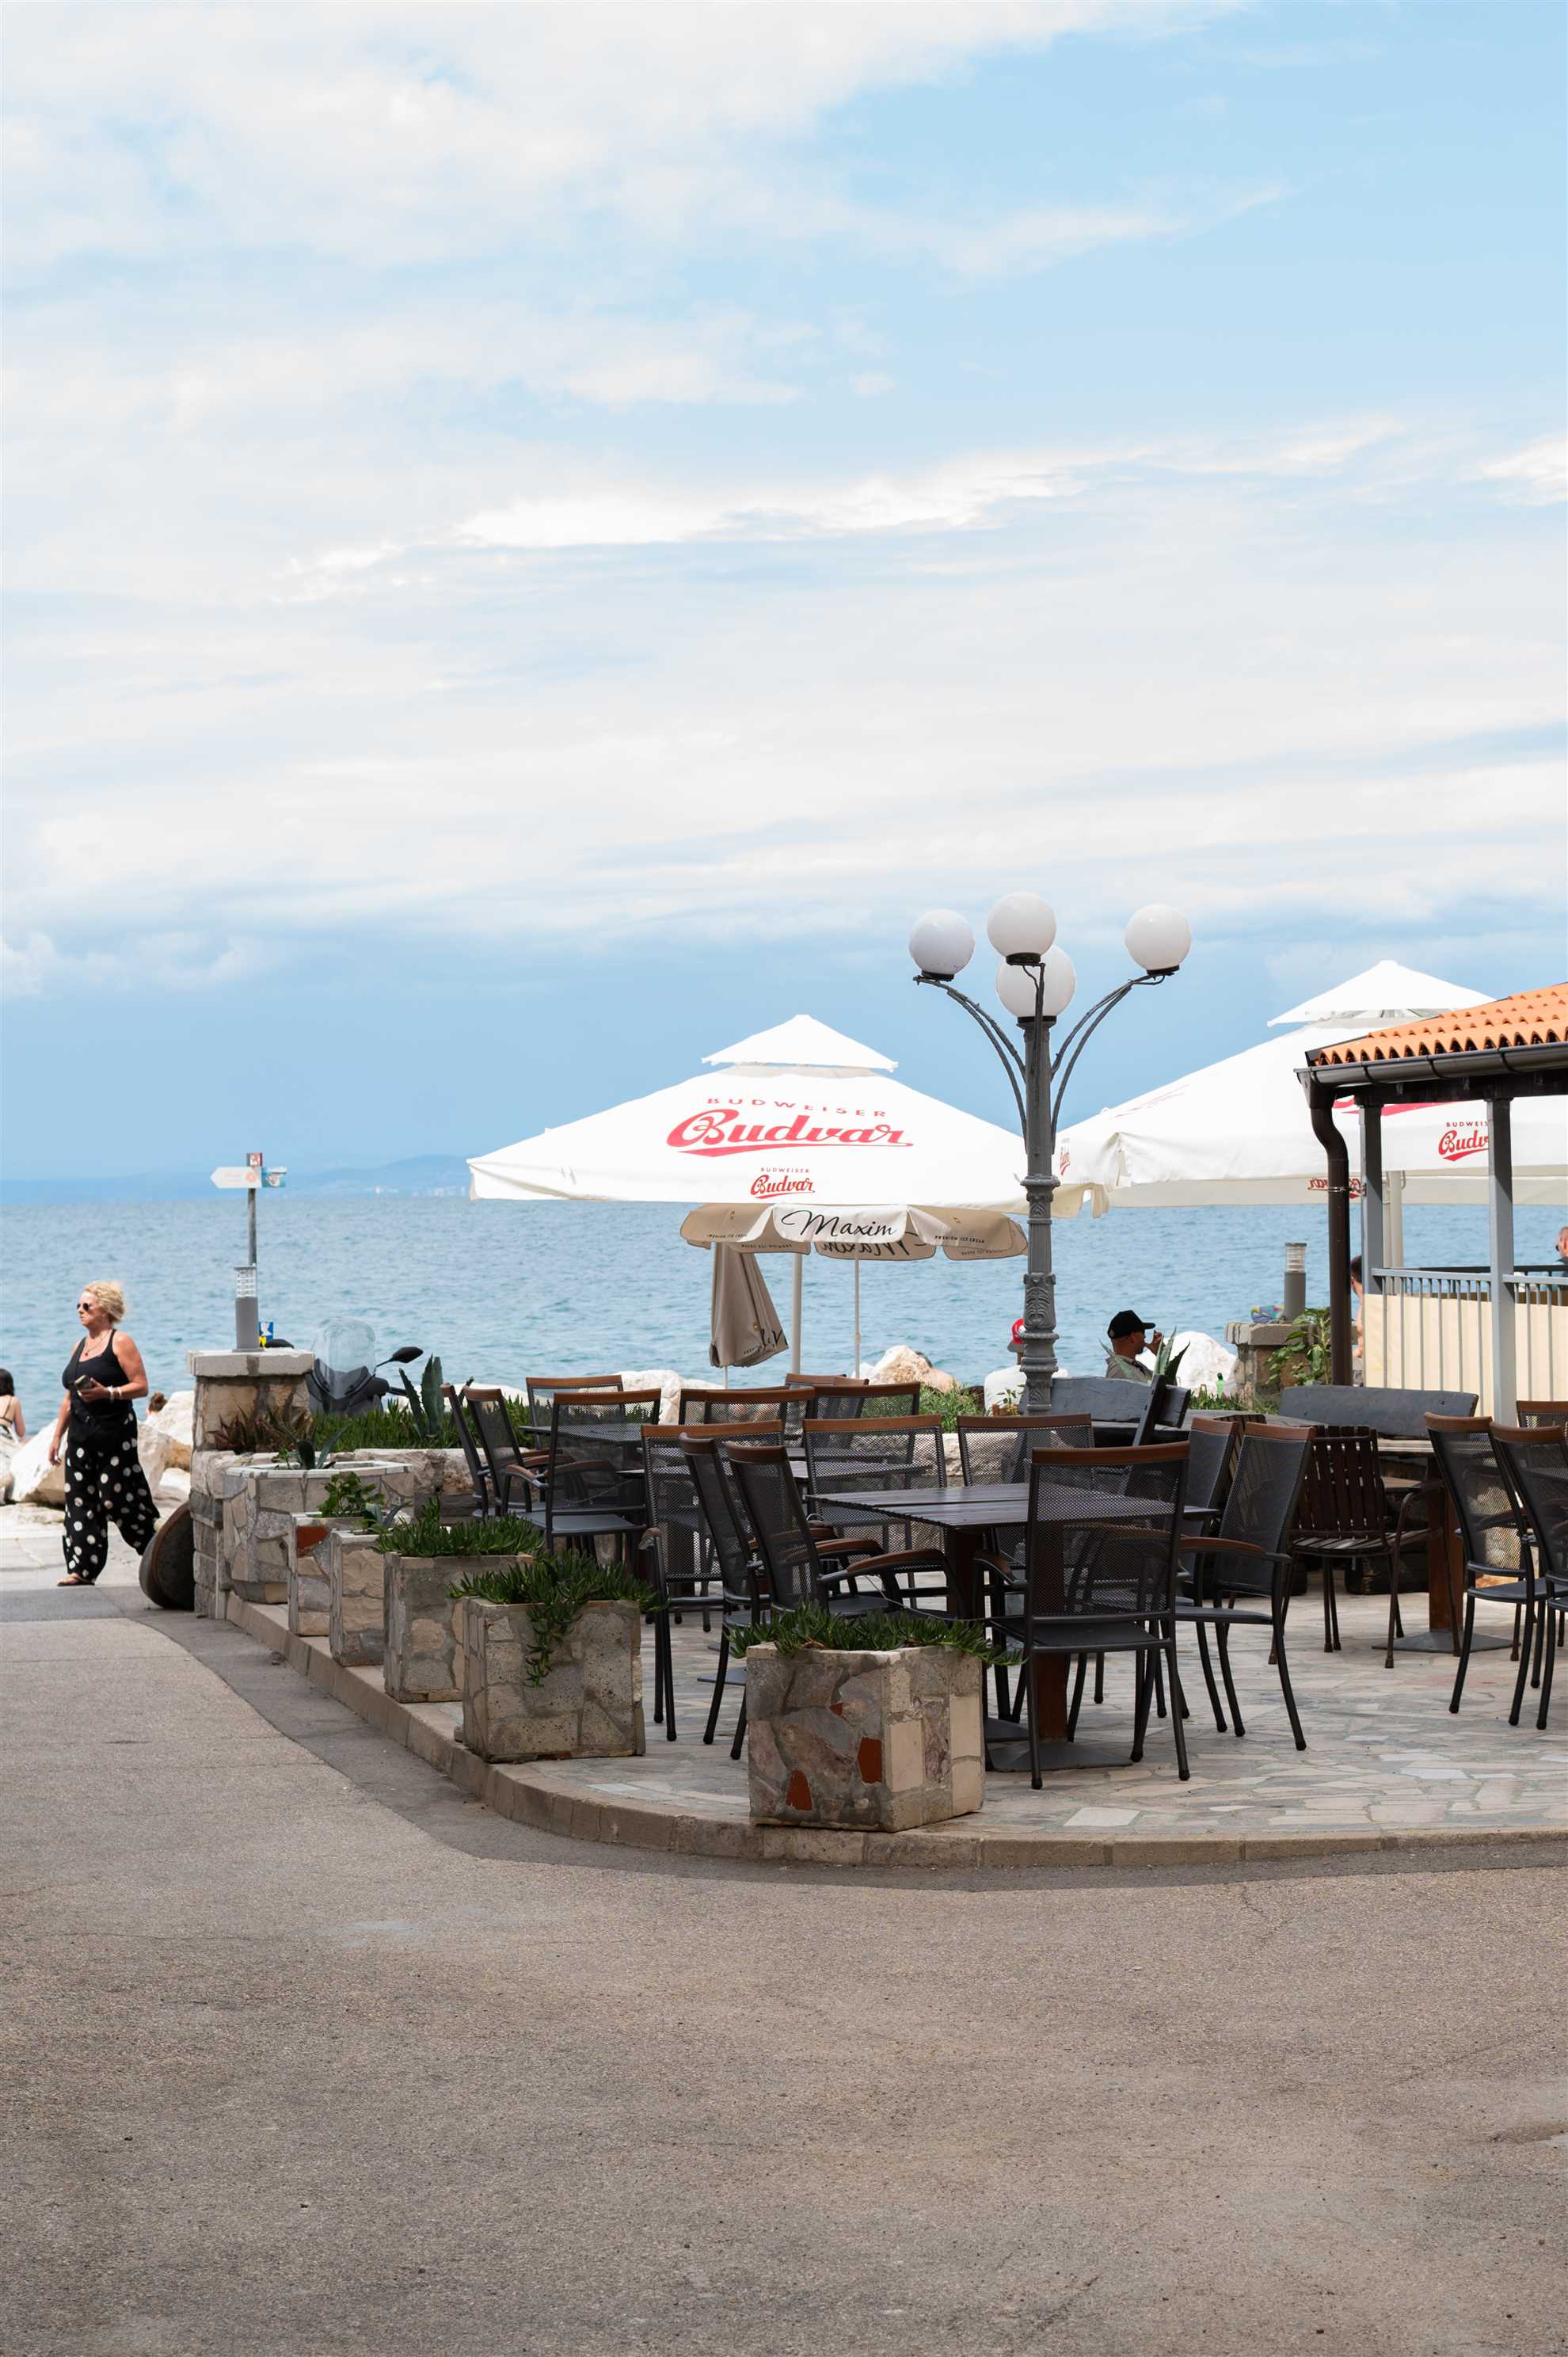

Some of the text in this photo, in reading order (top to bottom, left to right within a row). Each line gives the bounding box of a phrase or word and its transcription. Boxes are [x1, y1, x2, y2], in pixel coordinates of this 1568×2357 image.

[707, 1098, 886, 1118] BUDWEISER
[666, 1108, 914, 1157] Budvar
[1437, 1129, 1490, 1162] Budv
[750, 1174, 816, 1200] Budvar
[781, 1209, 896, 1238] Maxim
